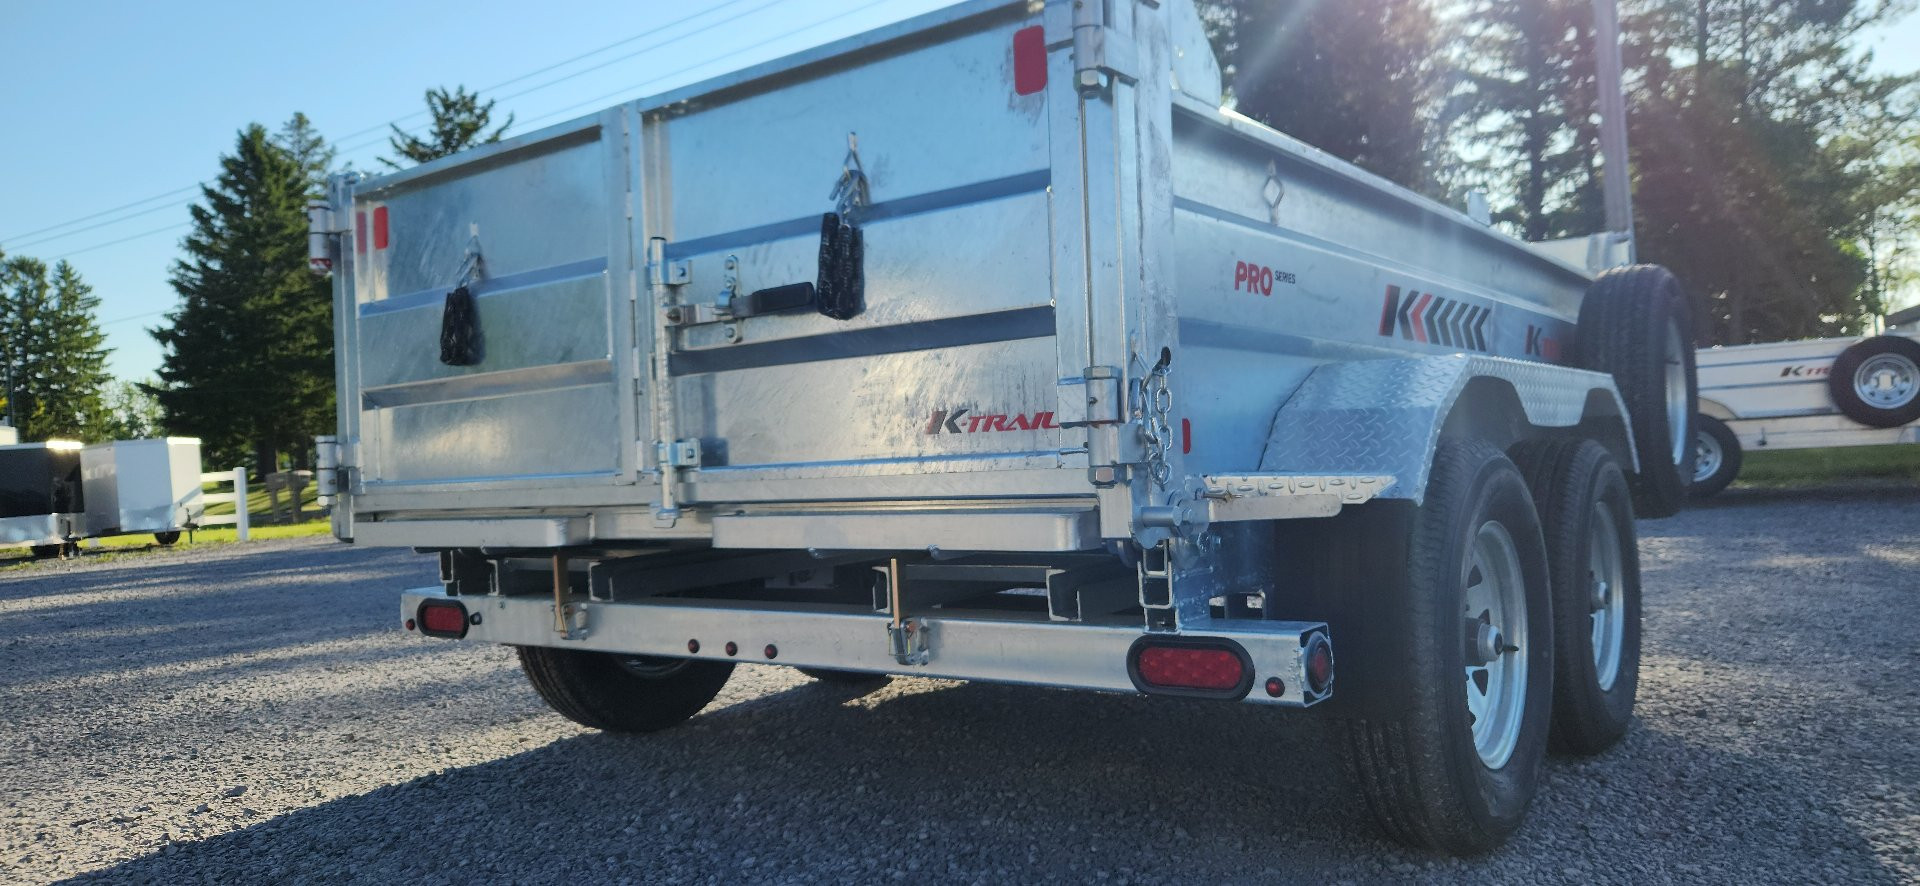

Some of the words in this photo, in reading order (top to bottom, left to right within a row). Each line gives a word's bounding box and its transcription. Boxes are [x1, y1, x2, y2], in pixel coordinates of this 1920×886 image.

[1234, 261, 1273, 297] PRO
[1274, 270, 1296, 285] SERIES
[925, 409, 1060, 435] K-TRAIL
